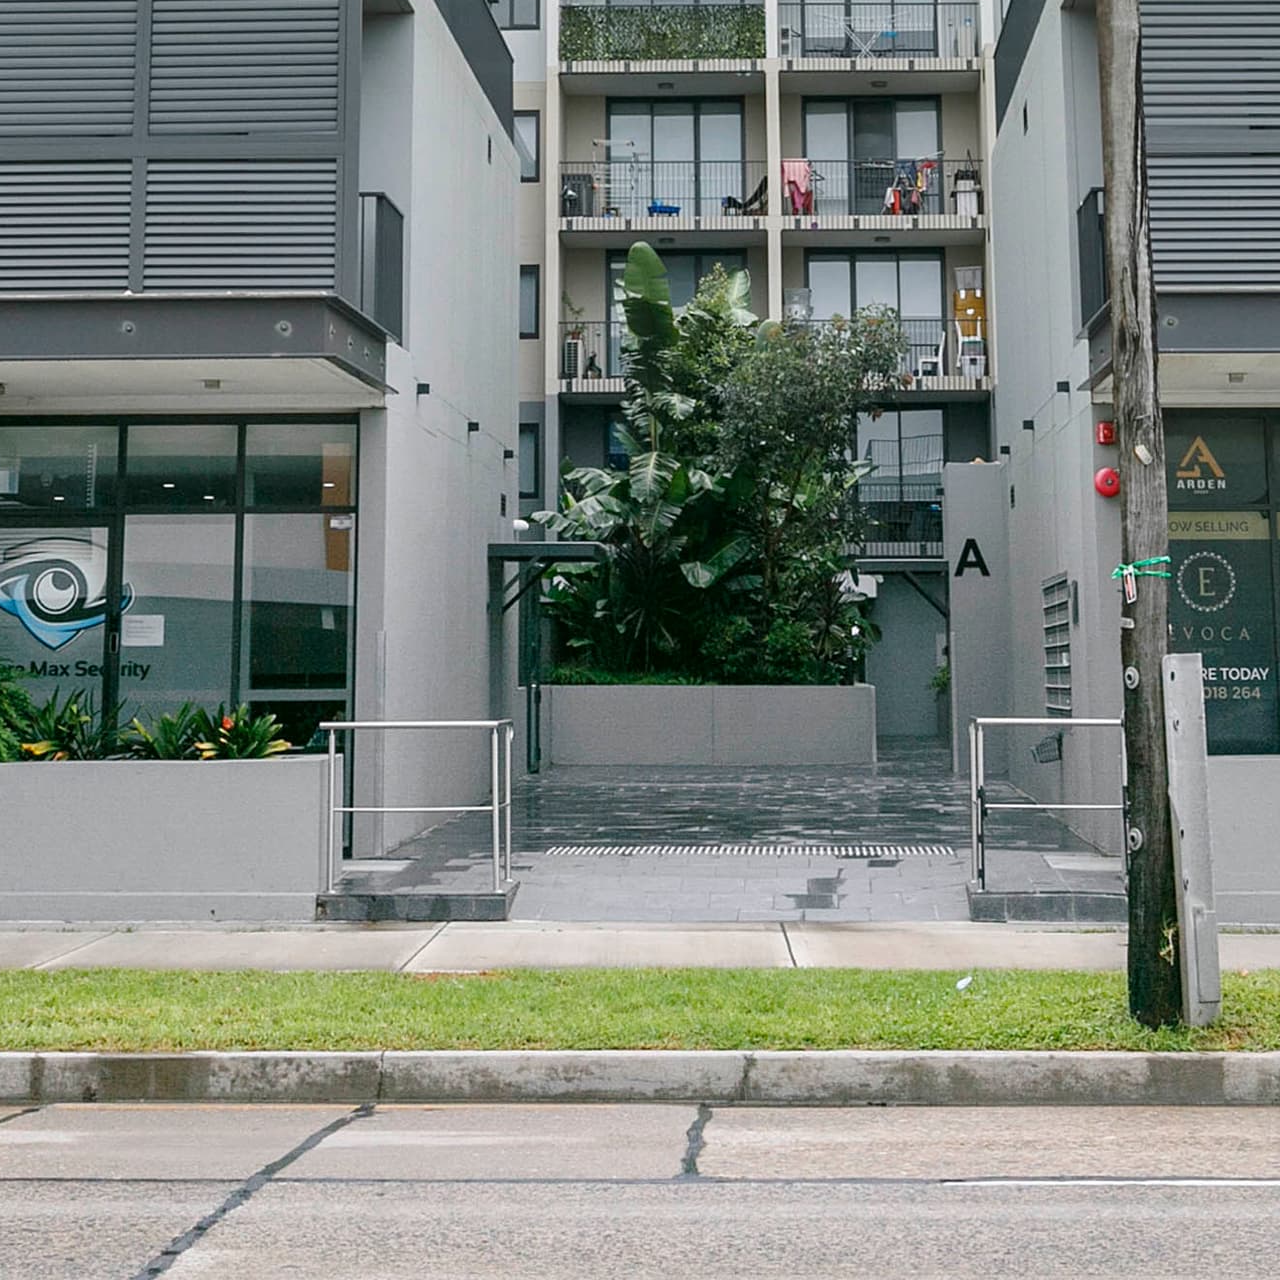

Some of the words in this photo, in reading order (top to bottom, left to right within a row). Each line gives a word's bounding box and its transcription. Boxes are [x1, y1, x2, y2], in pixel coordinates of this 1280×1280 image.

[1176, 479, 1226, 489] ARDEN
[1168, 521, 1192, 532] OW
[1194, 521, 1249, 533] SELLING
[954, 538, 991, 577] A
[30, 660, 70, 677] Max
[74, 660, 151, 681] Secrity
[1219, 667, 1270, 681] TODAY
[1232, 686, 1261, 699] 264
